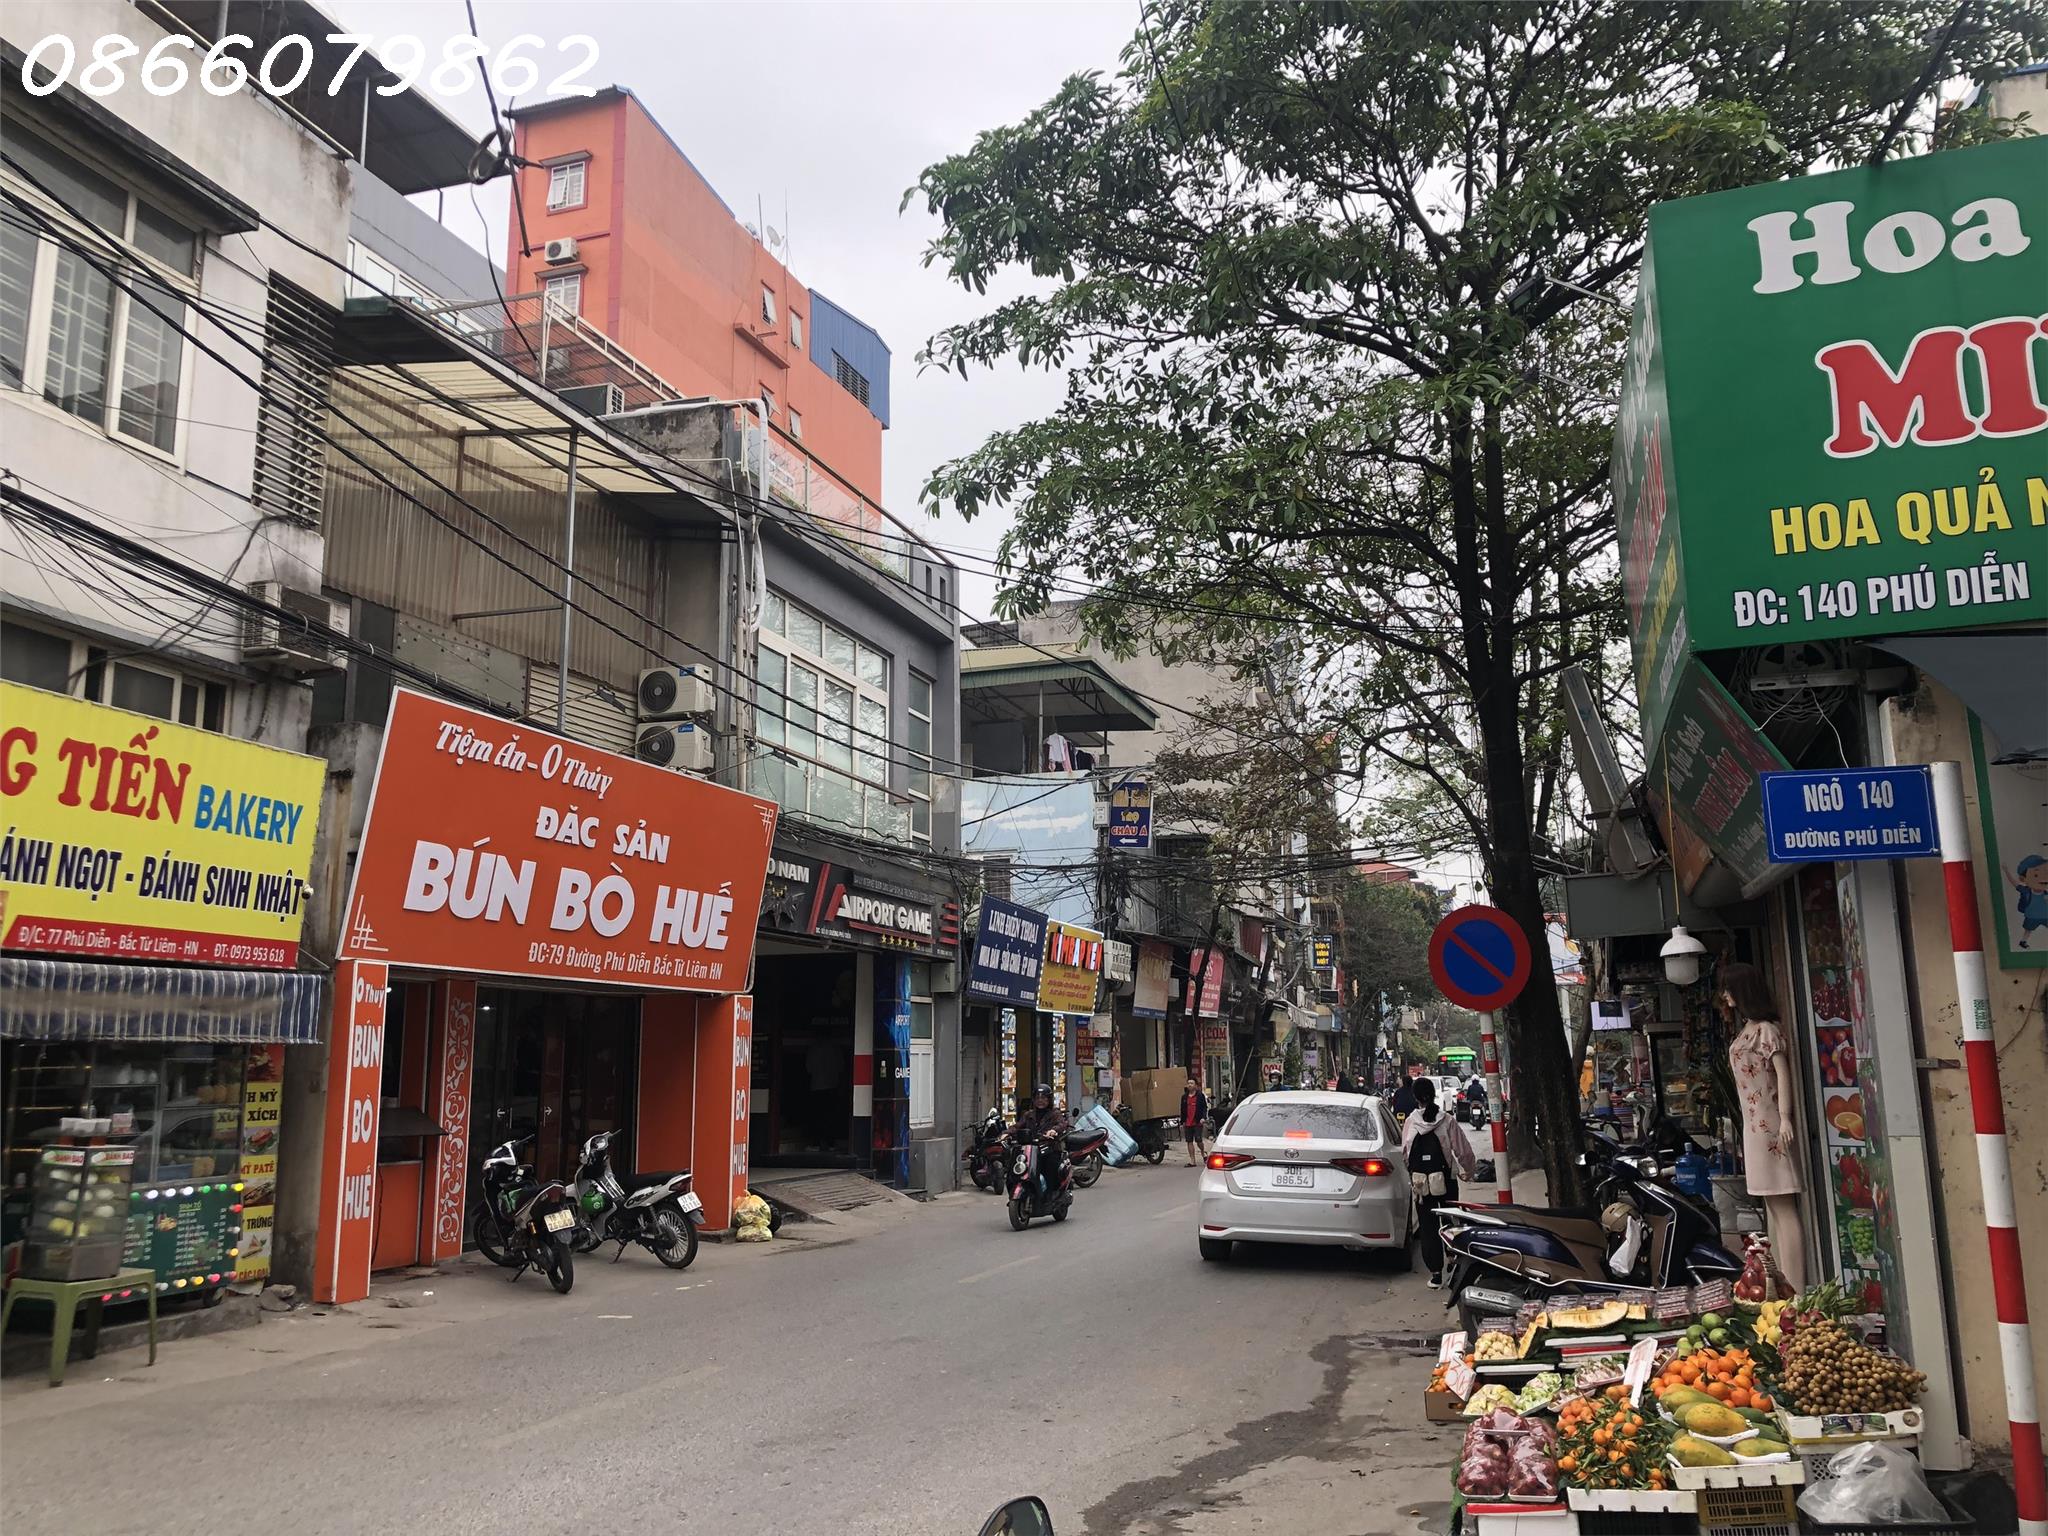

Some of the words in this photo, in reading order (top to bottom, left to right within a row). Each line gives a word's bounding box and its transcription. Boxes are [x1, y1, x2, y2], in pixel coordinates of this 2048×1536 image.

[1746, 197, 2032, 294] Hoa
[1815, 314, 2048, 459] MI
[1770, 498, 1880, 555] HOA
[1896, 466, 2013, 545] QUẢ
[1733, 588, 1789, 628] ĐC:
[1798, 580, 1856, 621] 140
[1867, 563, 1937, 614] PHÚ
[1946, 550, 2031, 607] DIỄN
[58, 725, 192, 825] TIẾN
[194, 784, 304, 845] BAKERY
[436, 720, 494, 765] Tiệm
[541, 743, 563, 780] O
[562, 757, 613, 800] Thúy
[1802, 777, 1844, 813] NGÕ
[1858, 780, 1895, 809] 140
[535, 805, 600, 848] ĐẶC
[612, 819, 671, 864] SẢN
[1784, 828, 1841, 850] ĐƯỜNG
[1845, 825, 1878, 846] PHÚ
[1883, 821, 1922, 844] DIỄN
[55, 843, 123, 902] NGỌT
[139, 849, 200, 904] BÁNH
[203, 864, 251, 910] SINH
[253, 868, 304, 923] NHẬT
[402, 836, 537, 925] BÚN
[549, 862, 635, 938] BÒ
[648, 881, 734, 951] HUẾ
[778, 861, 810, 884] NAM
[824, 884, 896, 927] AIRPORT
[897, 906, 933, 936] GAME
[18, 926, 46, 946] Đ/C:
[49, 928, 62, 944] 77
[64, 929, 86, 948] Phú
[87, 929, 111, 948] Diễn
[119, 931, 138, 951] Bắc
[139, 935, 154, 952] Từ
[154, 936, 177, 954] Liêm
[184, 940, 199, 956] HN
[214, 944, 229, 958] ĐT:
[230, 944, 251, 961] 0973
[252, 945, 268, 962] 953
[269, 947, 285, 963] 618
[566, 945, 602, 974] Đường
[603, 951, 626, 972] Phú
[627, 951, 651, 974] Diễn
[653, 953, 672, 976] Bắc
[685, 959, 708, 980] Liêm
[709, 963, 723, 980] HN
[353, 1018, 381, 1069] BÚN
[735, 1033, 750, 1067] BÚN
[894, 1067, 911, 1079] GAME
[247, 1107, 278, 1122] XÍCH
[351, 1094, 374, 1144] BÒ
[735, 1088, 746, 1121] BÒ
[732, 1137, 747, 1175] HUẾ
[1276, 1175, 1309, 1185] 886.54
[343, 1168, 373, 1221] HUẾ
